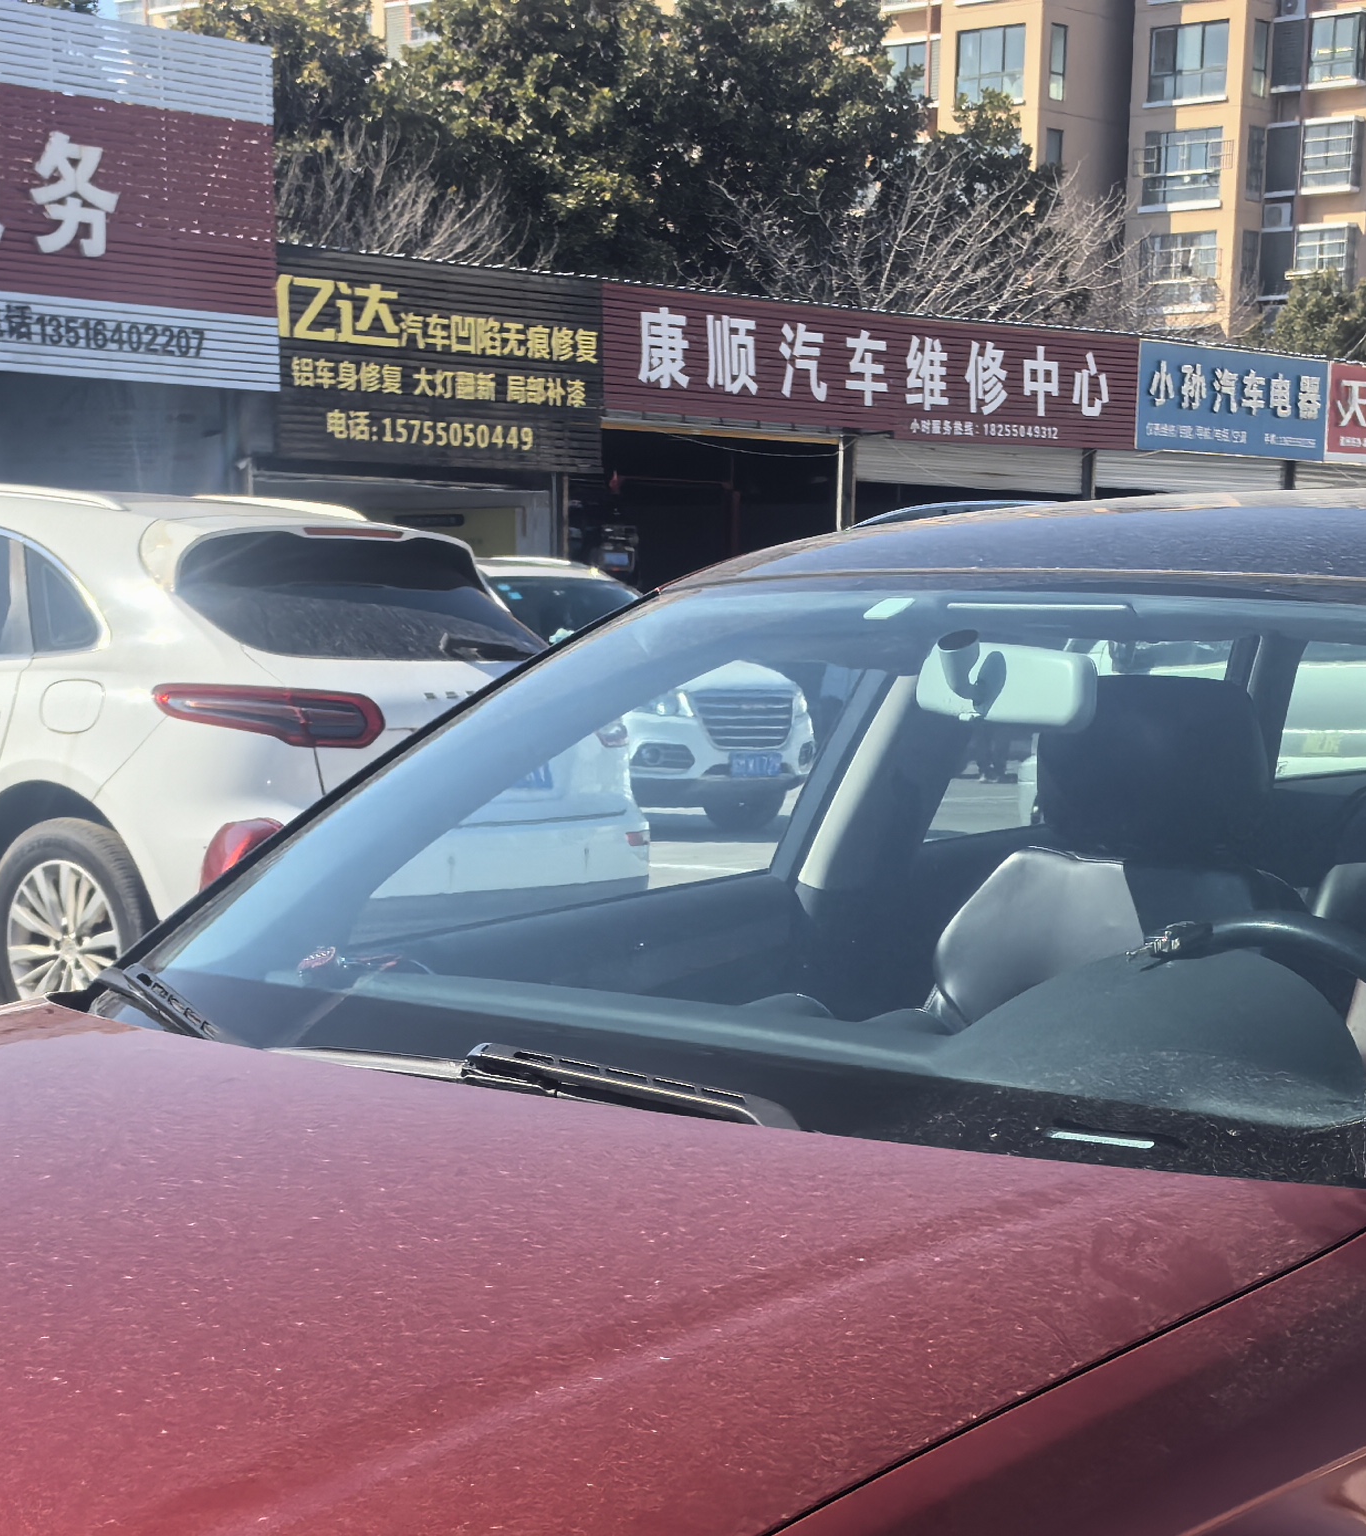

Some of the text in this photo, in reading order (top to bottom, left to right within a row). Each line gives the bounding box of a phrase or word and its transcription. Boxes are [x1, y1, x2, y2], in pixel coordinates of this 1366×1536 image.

[276, 274, 400, 348] 亿达
[291, 355, 403, 395] 铝车身修复
[506, 375, 586, 409] 局部补漆
[637, 306, 1110, 418] 康顺汽车维修中心
[1148, 358, 1322, 421] 小孙汽车电器
